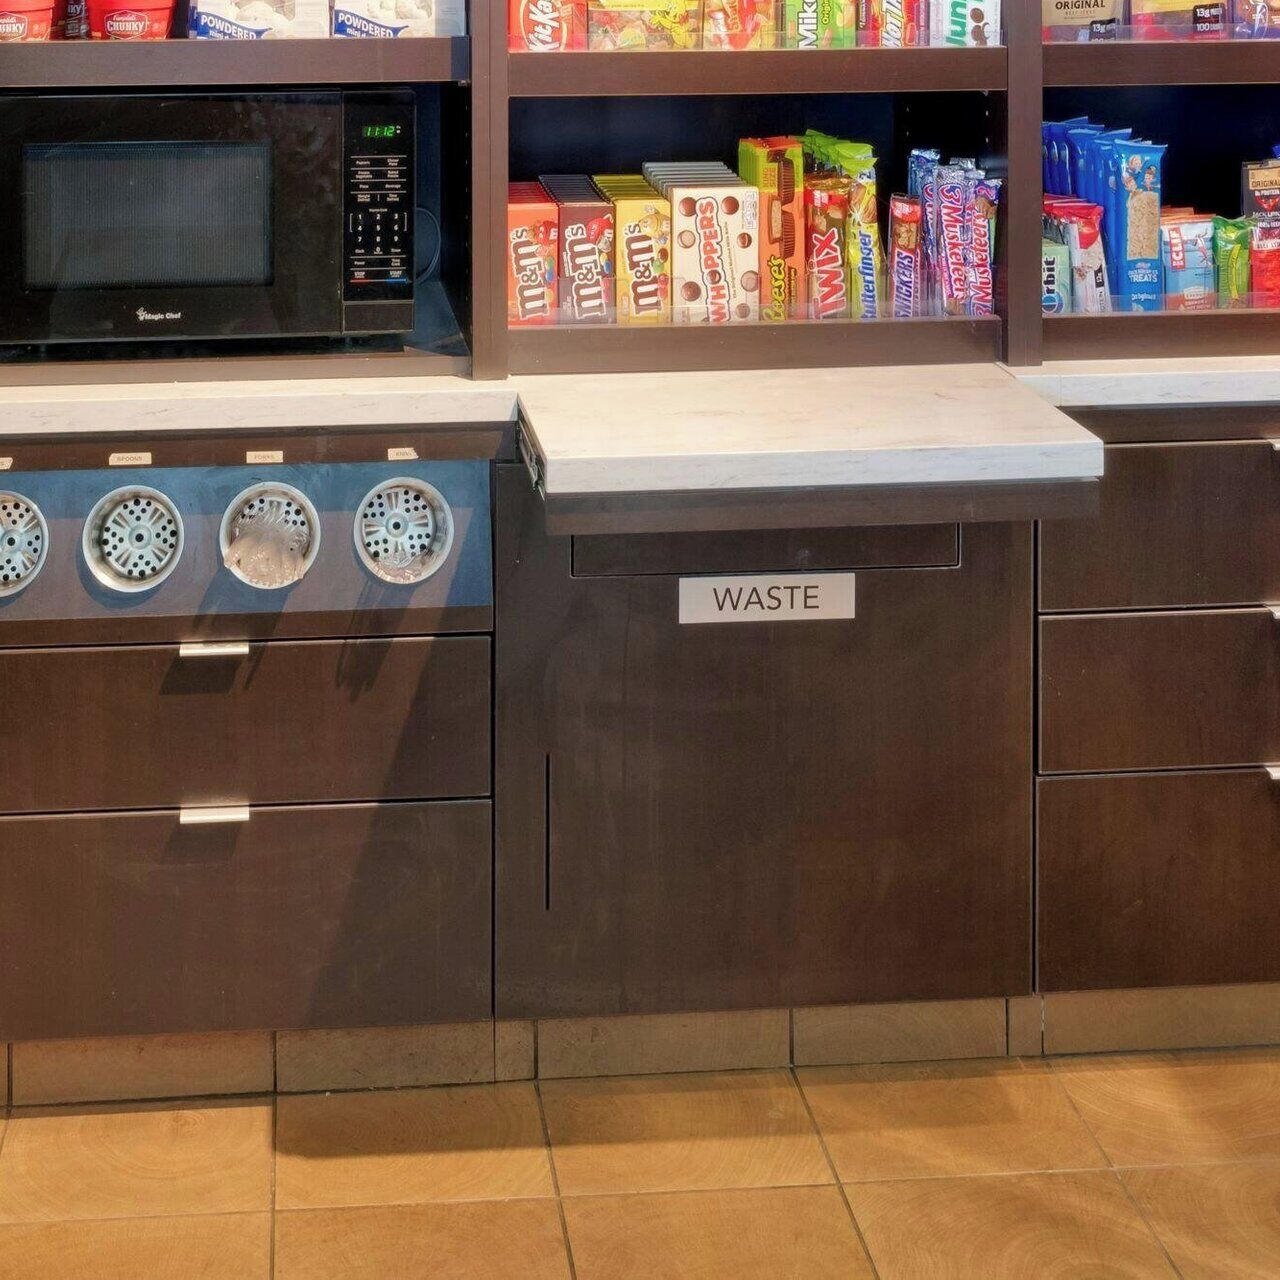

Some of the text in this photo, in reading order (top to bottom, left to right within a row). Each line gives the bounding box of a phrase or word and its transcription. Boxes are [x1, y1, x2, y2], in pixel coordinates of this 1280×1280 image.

[1055, 0, 1106, 11] ORIGINAL
[106, 21, 146, 33] CHUNKY
[200, 15, 257, 39] POWDERED
[337, 12, 394, 38] POWDERED
[697, 200, 730, 322] WHOPPERS
[940, 206, 966, 304] Musketeers
[814, 228, 847, 320] TWIX
[894, 250, 914, 320] SNICKERS
[1129, 274, 1158, 283] TREATS
[145, 312, 165, 321] Magic
[713, 585, 820, 611] WASTE
